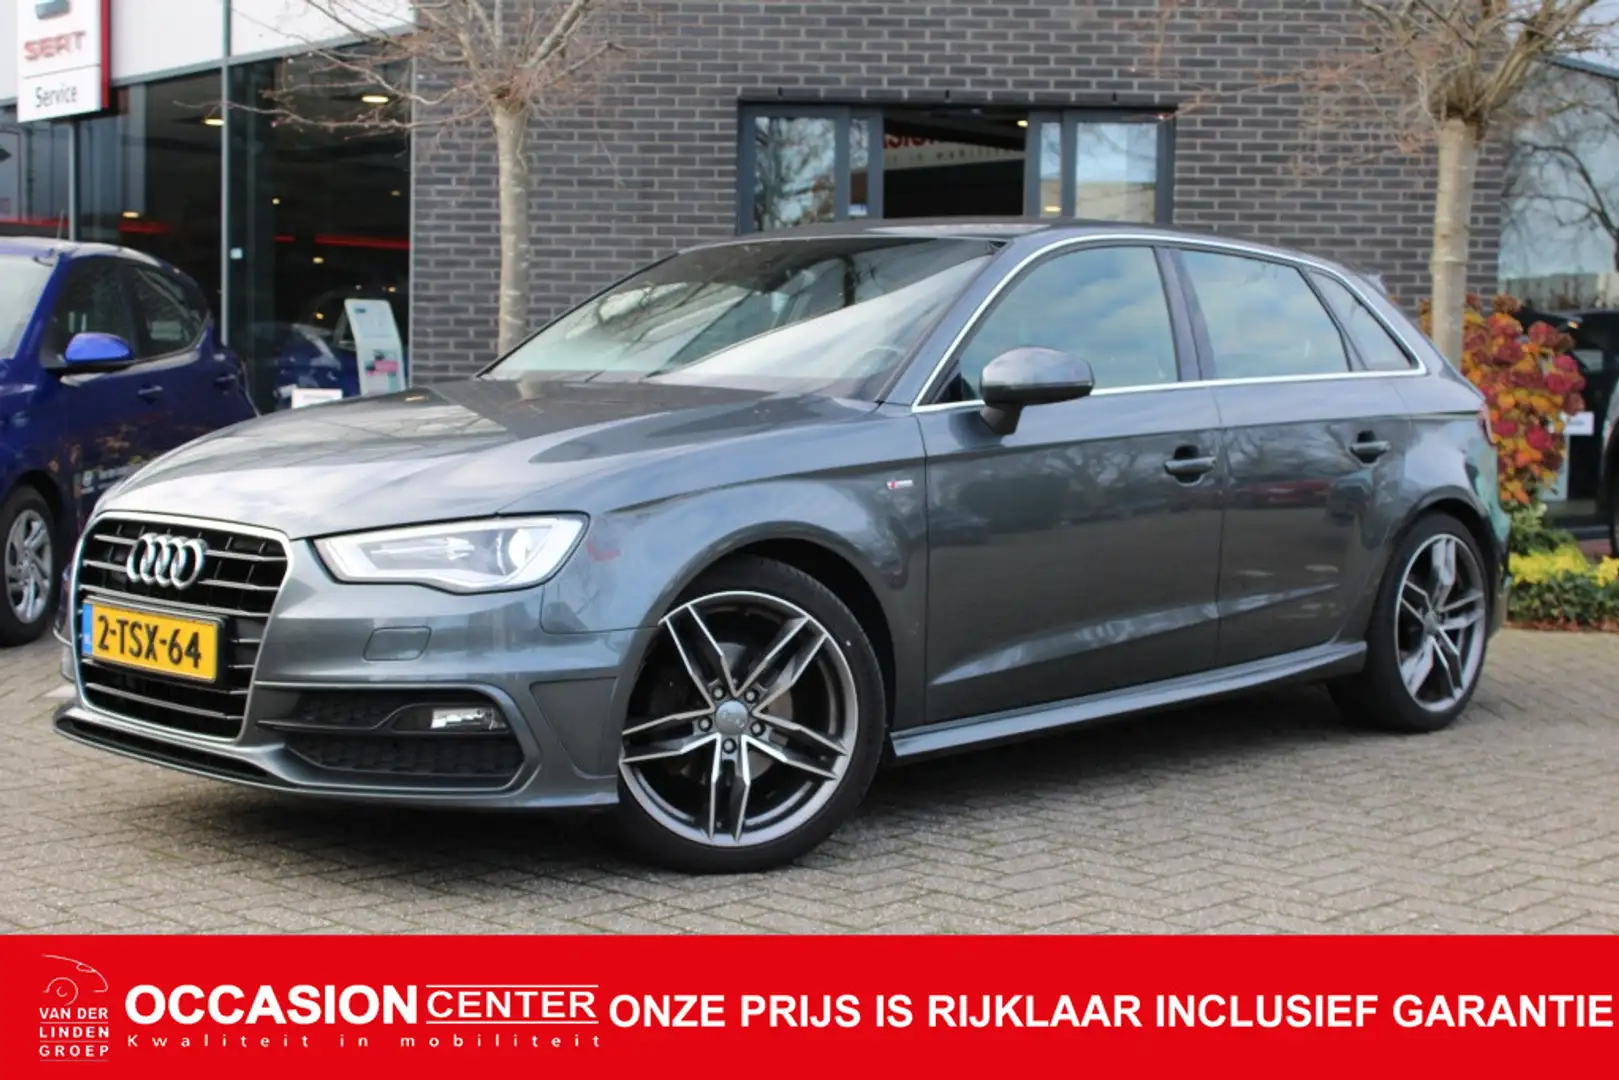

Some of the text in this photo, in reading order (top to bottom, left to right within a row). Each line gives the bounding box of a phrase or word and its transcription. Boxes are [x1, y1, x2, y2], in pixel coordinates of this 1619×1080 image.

[24, 30, 86, 61] SEAT
[36, 82, 78, 108] Service
[98, 614, 203, 670] 2-TSX-64
